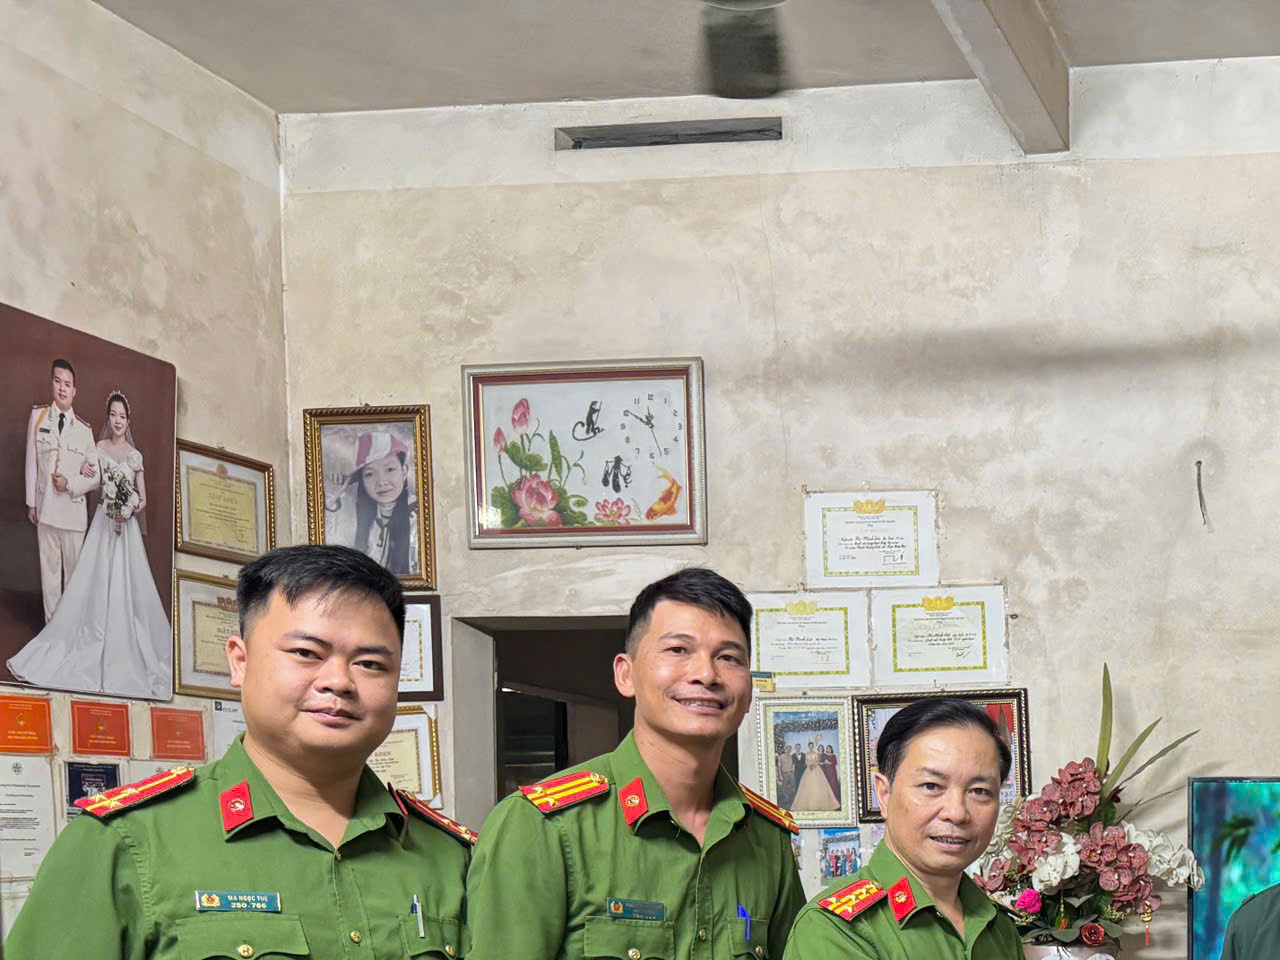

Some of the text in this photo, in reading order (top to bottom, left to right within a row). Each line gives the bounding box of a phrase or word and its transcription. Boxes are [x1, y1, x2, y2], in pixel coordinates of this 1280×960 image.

[647, 393, 654, 401] 12
[673, 409, 678, 417] 2
[635, 447, 641, 455] 7
[663, 447, 669, 455] 5
[649, 452, 655, 460] 6
